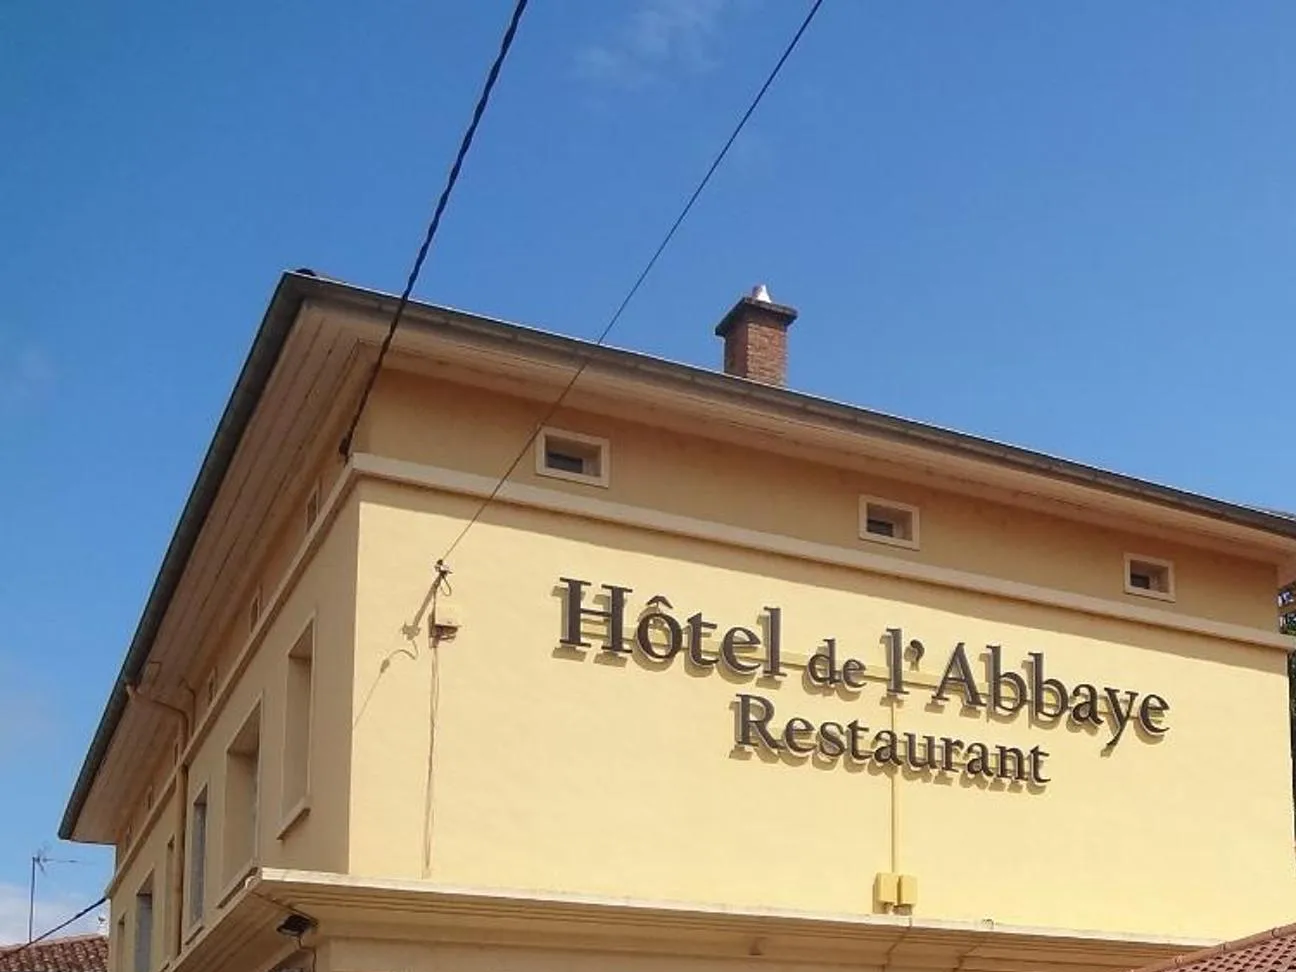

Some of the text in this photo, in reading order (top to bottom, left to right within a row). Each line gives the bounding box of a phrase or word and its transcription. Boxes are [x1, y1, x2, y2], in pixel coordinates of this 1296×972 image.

[559, 577, 1171, 750] Hôtel de l'Abbaye
[734, 693, 1052, 784] Restaurant
